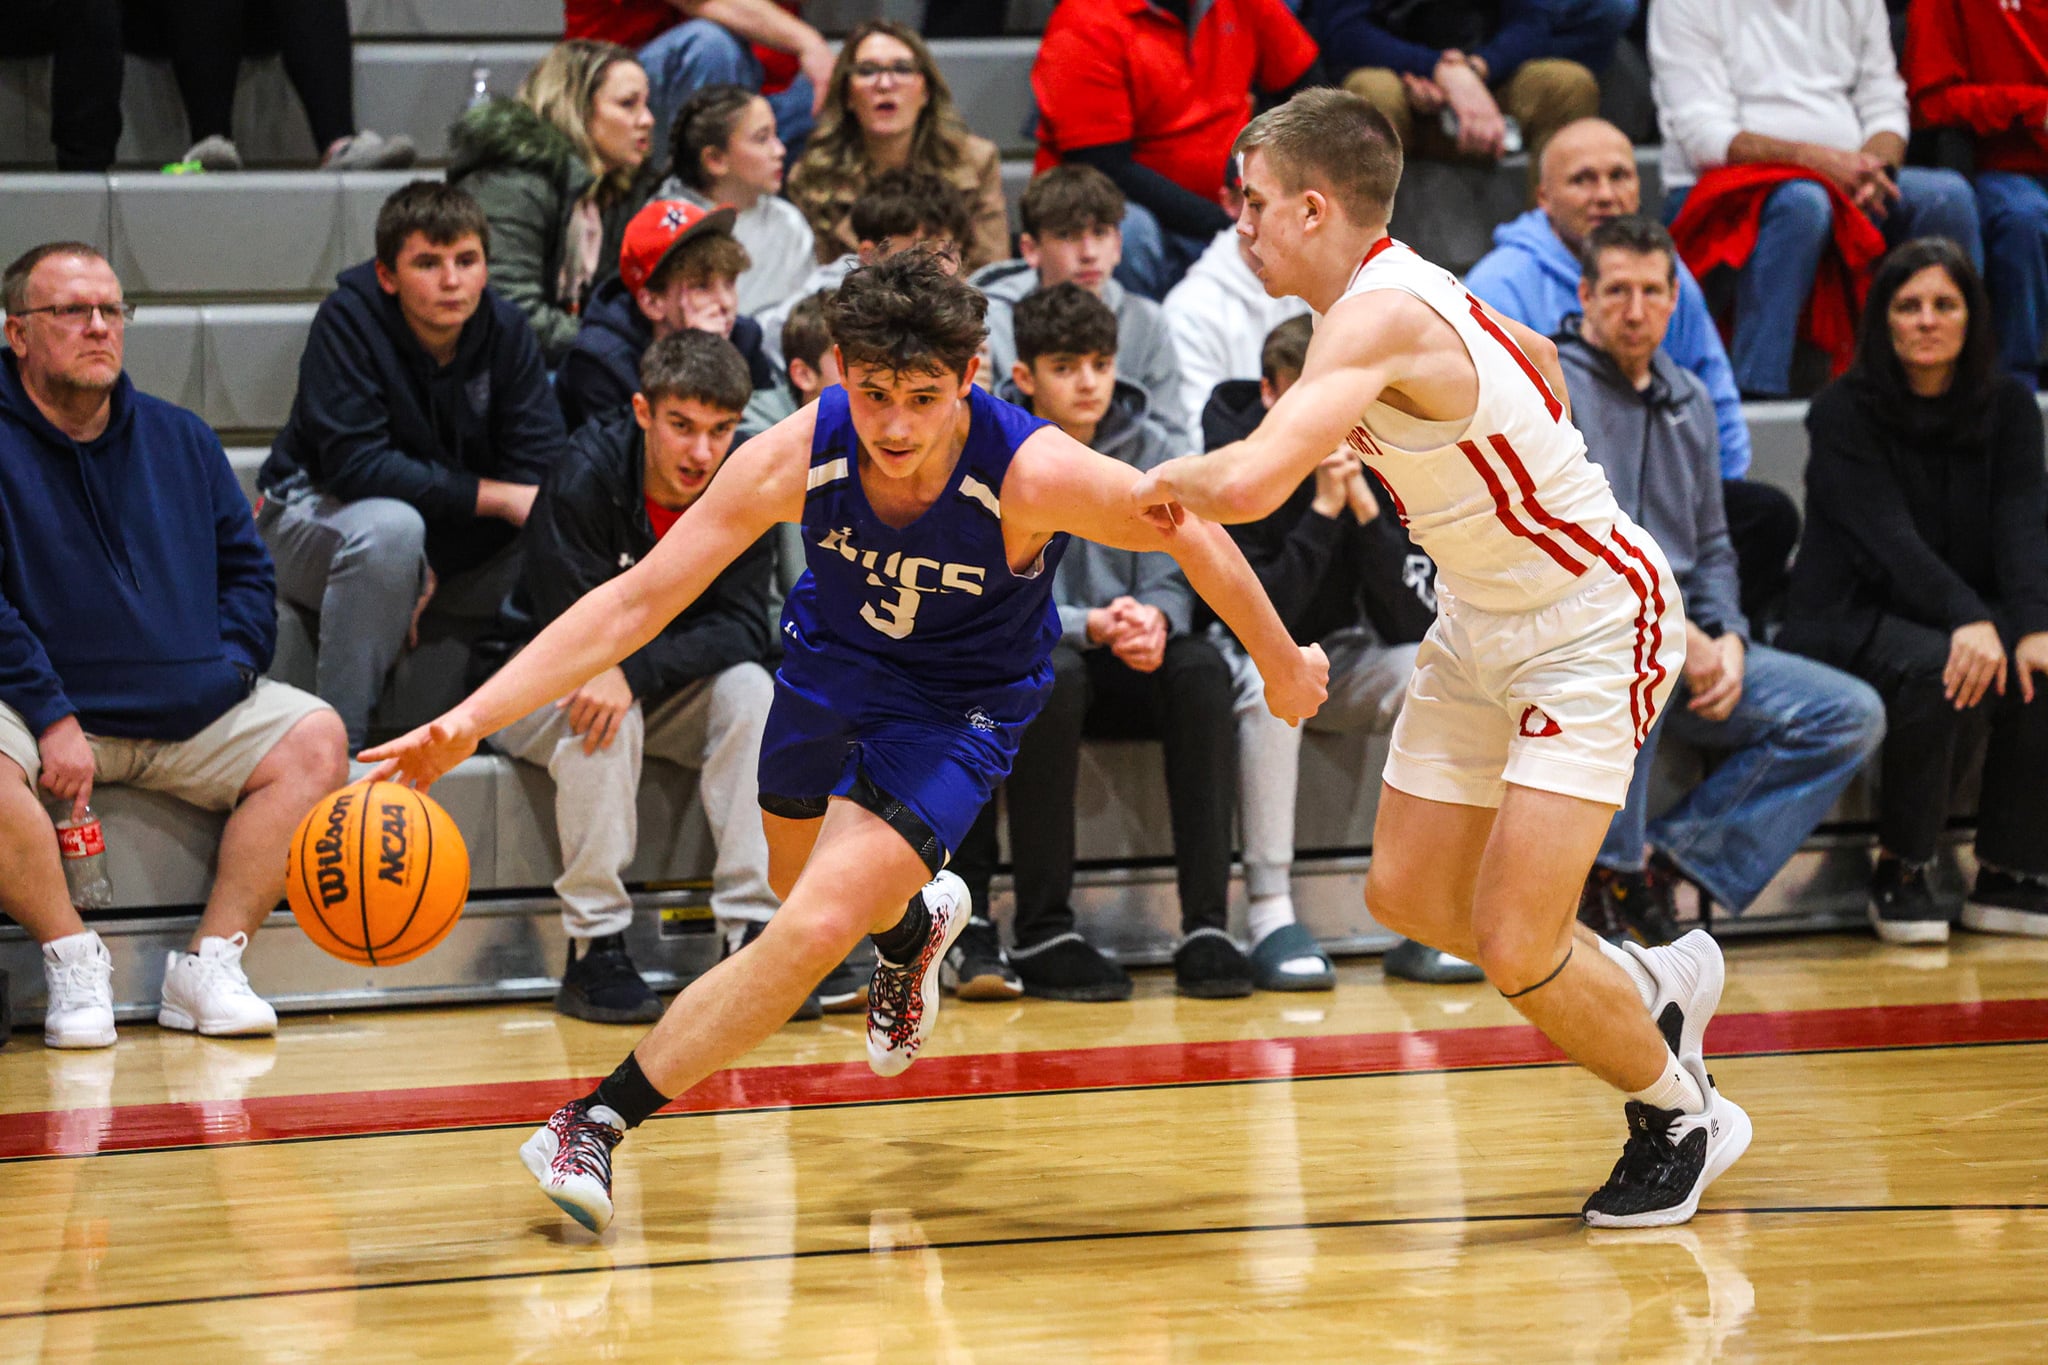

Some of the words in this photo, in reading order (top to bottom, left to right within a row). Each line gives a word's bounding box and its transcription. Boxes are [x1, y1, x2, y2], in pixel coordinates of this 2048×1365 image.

[859, 572, 921, 640] 3
[315, 794, 353, 909] Wilson
[378, 804, 406, 885] NCAA
